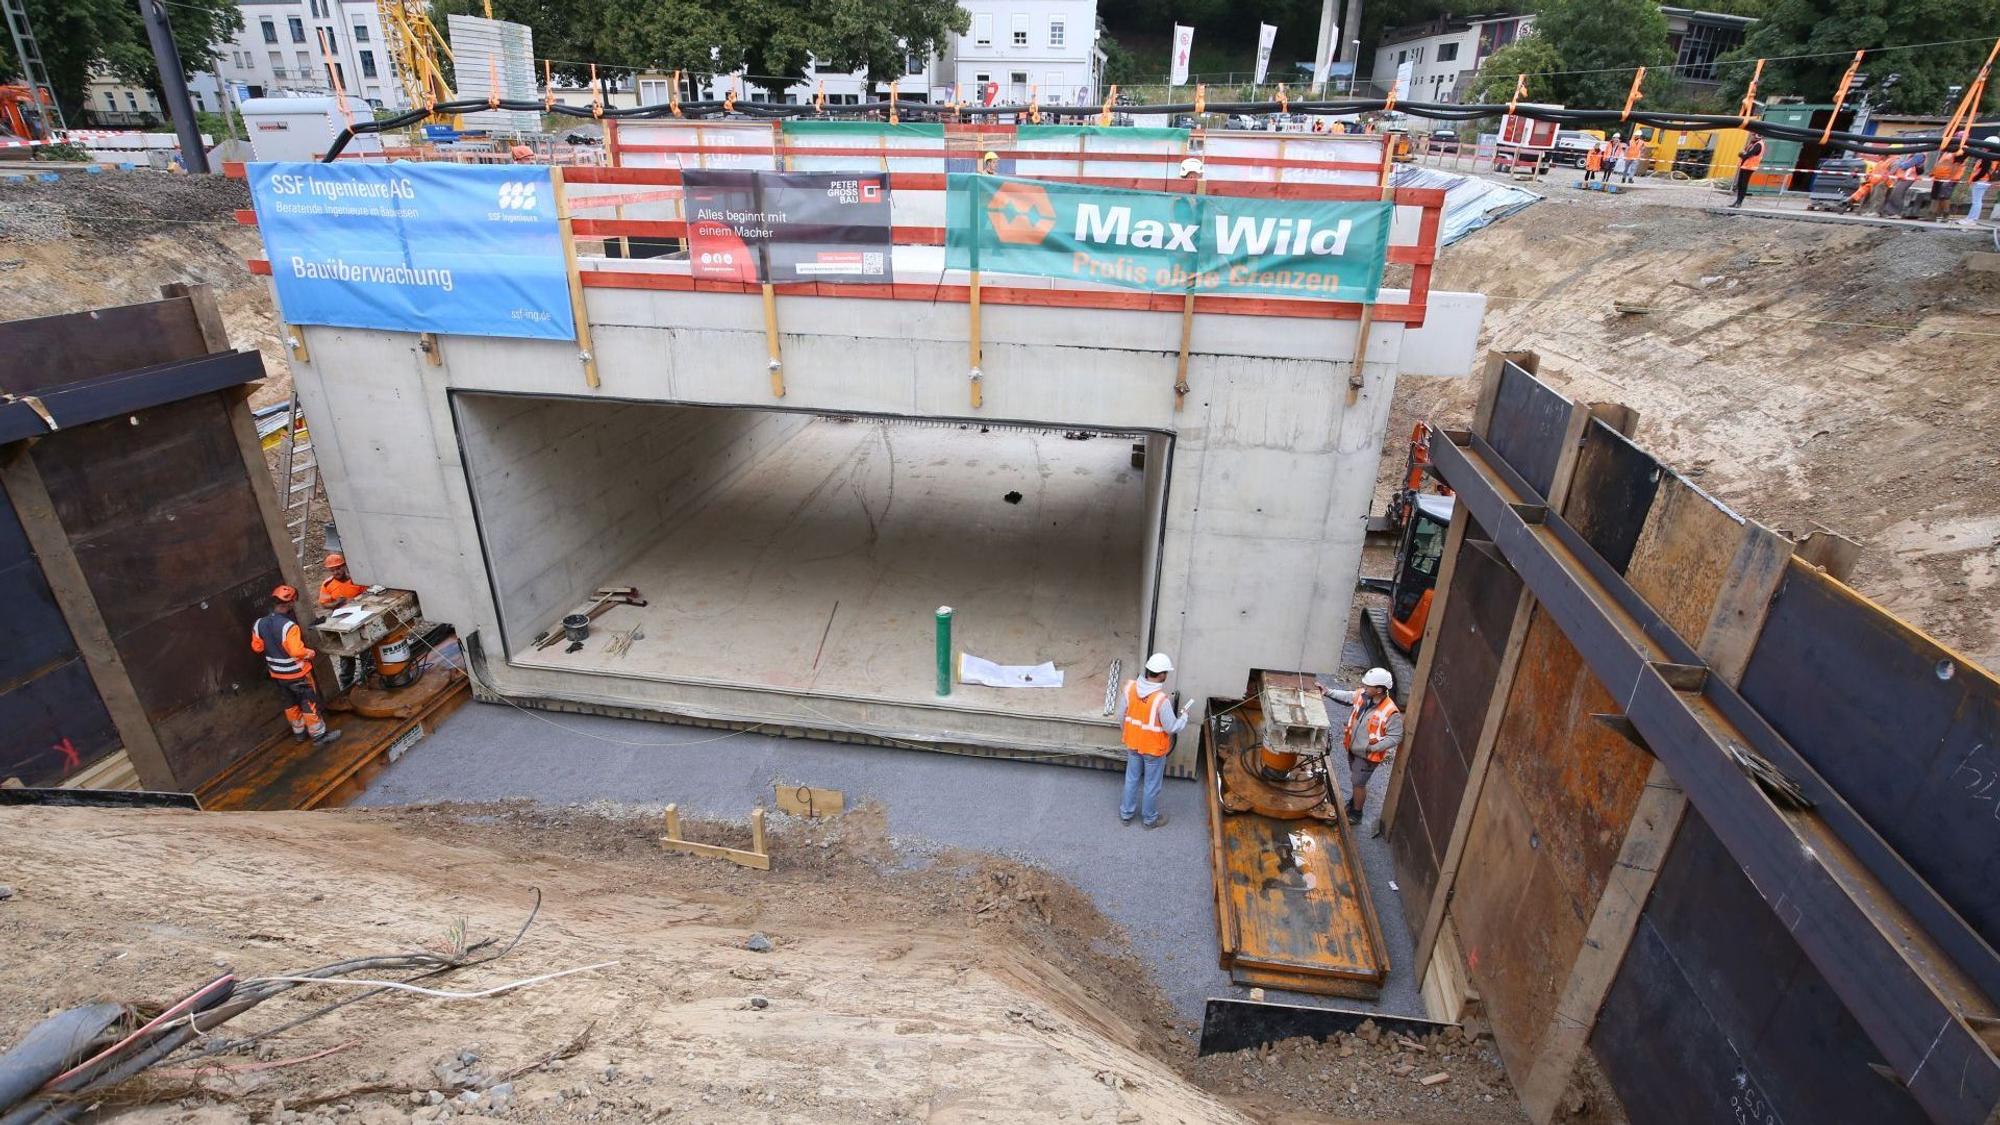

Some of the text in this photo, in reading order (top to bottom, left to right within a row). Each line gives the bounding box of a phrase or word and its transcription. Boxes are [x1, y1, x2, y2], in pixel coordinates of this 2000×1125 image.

[271, 174, 415, 200] SSF Ingenieure AG
[831, 180, 858, 189] PETER
[827, 188, 858, 197] GROSS
[840, 196, 859, 204] BAU
[276, 200, 323, 214] Beratende
[697, 208, 787, 224] Alles beginnt mit
[699, 226, 774, 239] einem Macher
[1075, 203, 1353, 257] Max Wild
[291, 256, 453, 292] Bauüberwachung
[1072, 252, 1340, 294] Profis ohne Grenzen
